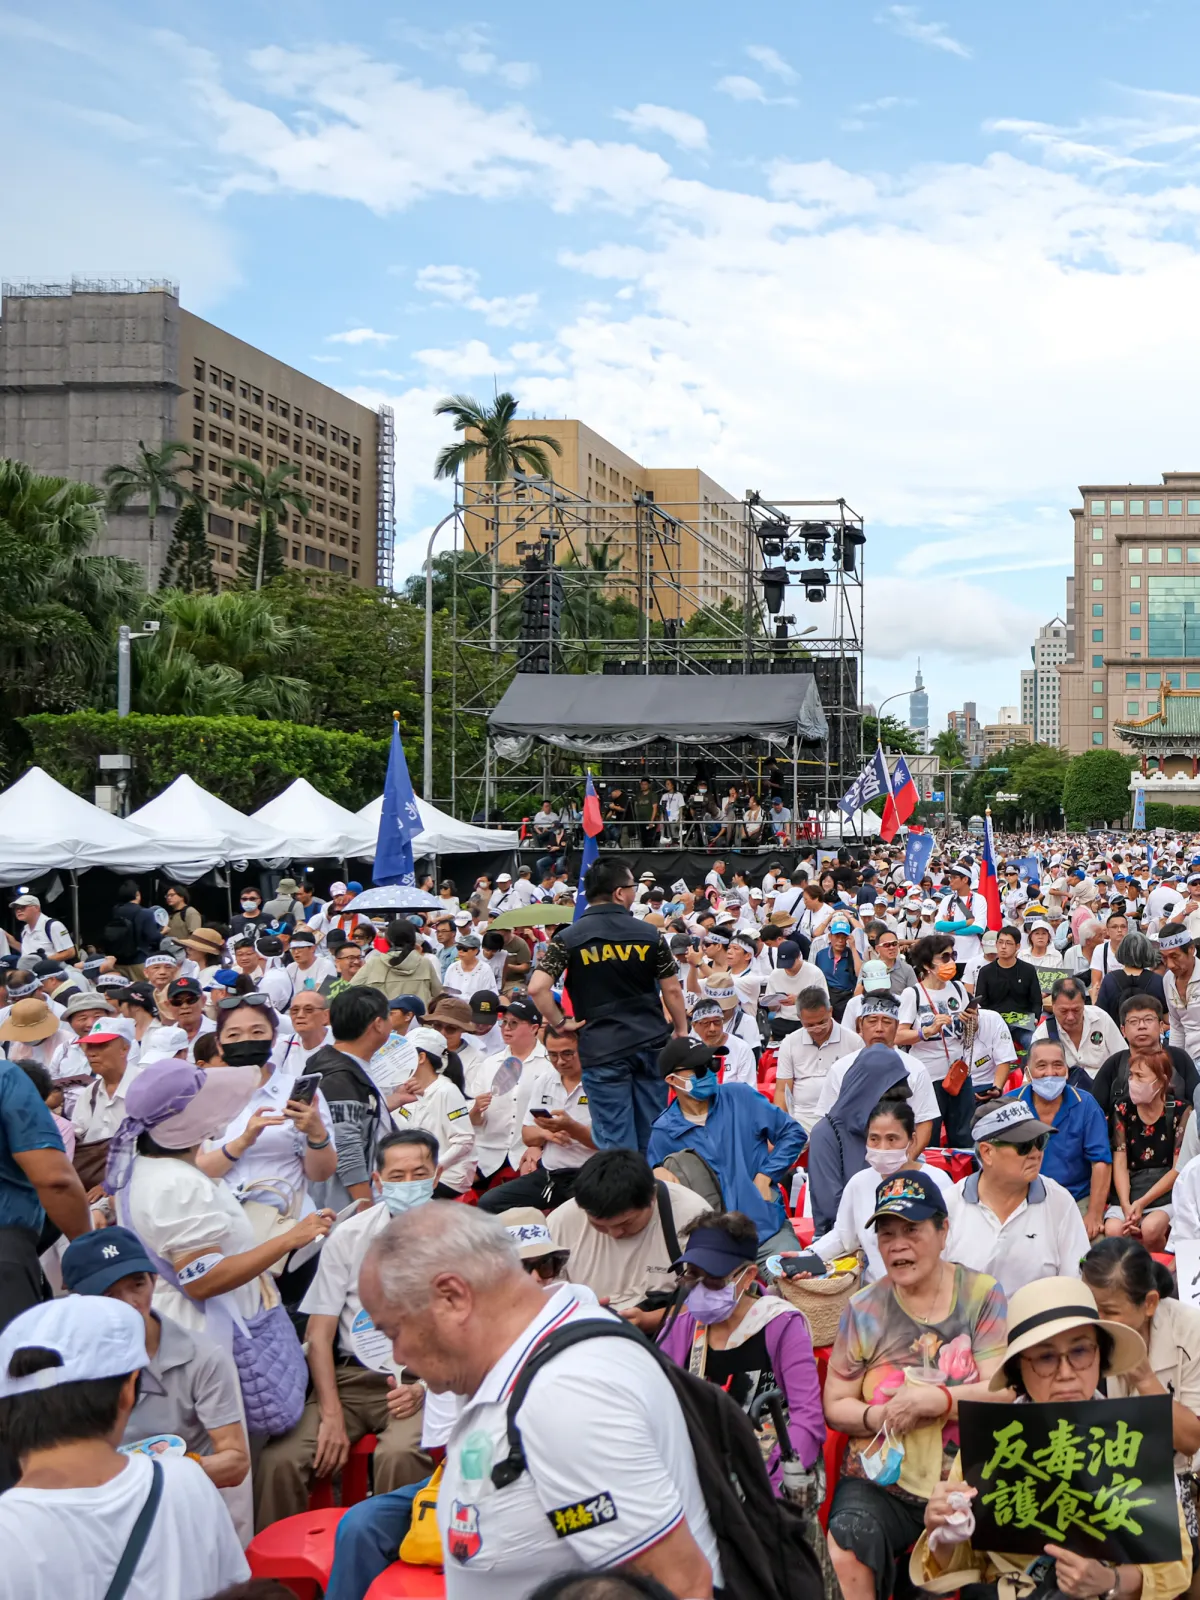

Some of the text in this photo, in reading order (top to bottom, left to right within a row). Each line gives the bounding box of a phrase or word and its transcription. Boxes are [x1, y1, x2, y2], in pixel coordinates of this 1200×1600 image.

[580, 944, 650, 966] NAVY
[102, 1245, 119, 1258] NY
[980, 1418, 1144, 1482] 反毒油
[981, 1473, 1157, 1542] 護食安
